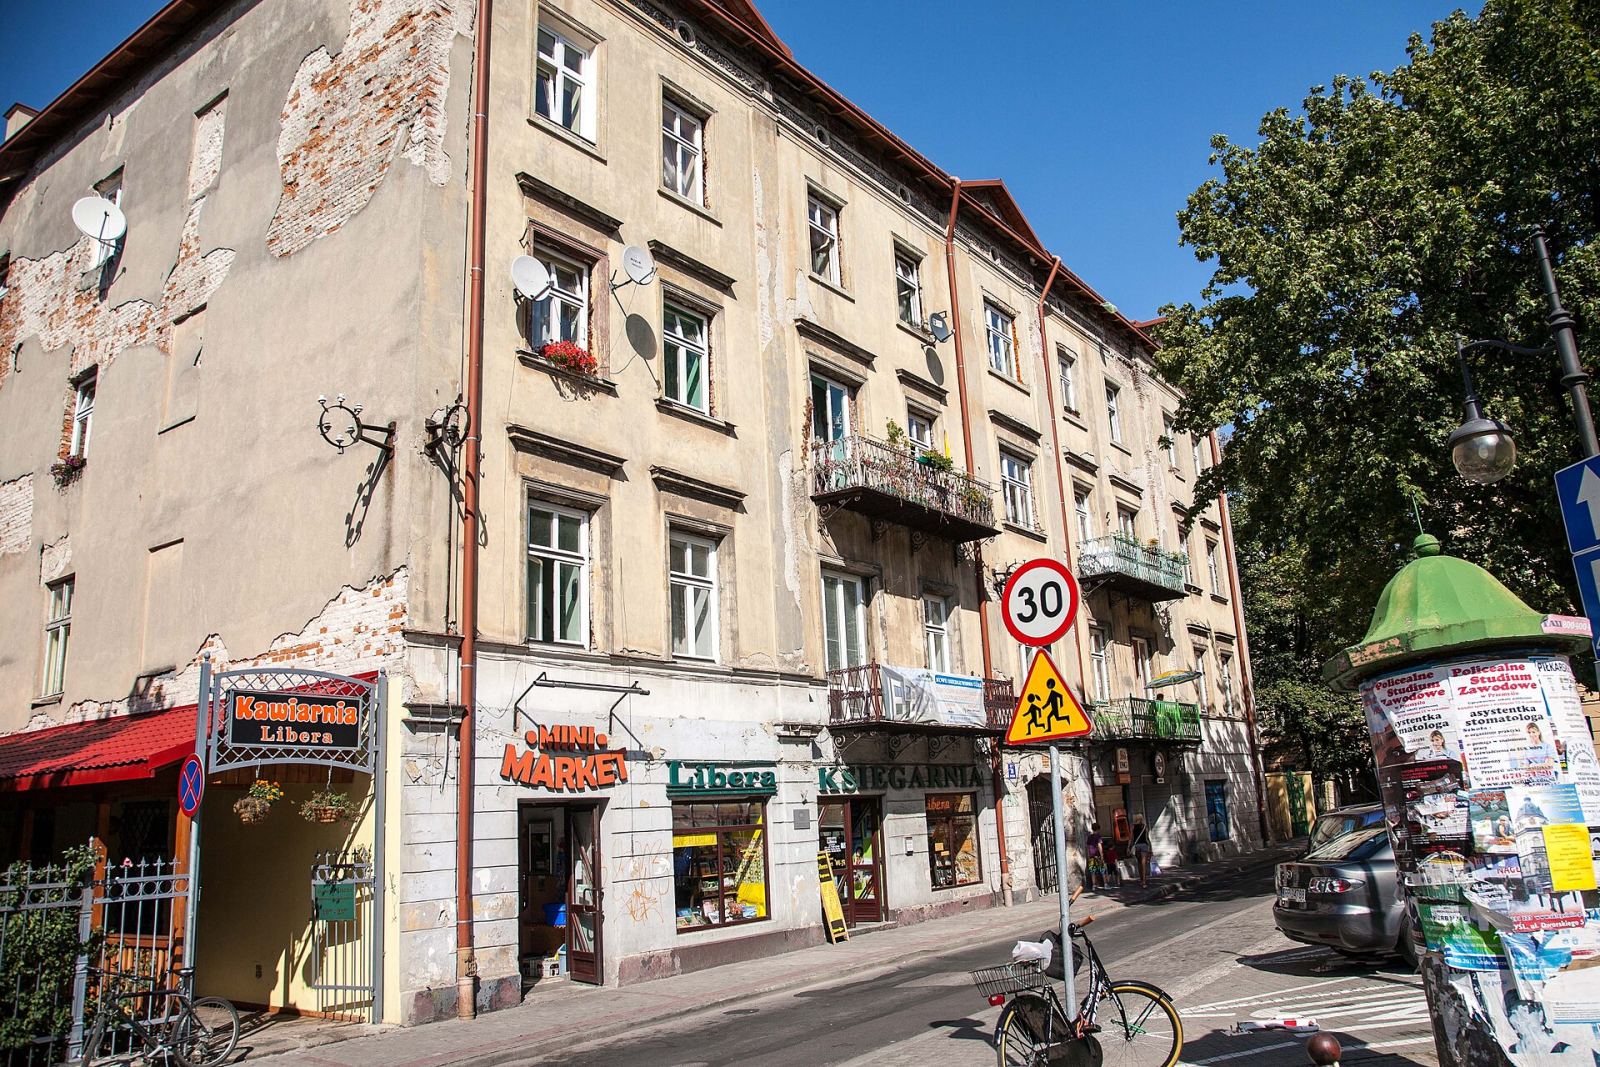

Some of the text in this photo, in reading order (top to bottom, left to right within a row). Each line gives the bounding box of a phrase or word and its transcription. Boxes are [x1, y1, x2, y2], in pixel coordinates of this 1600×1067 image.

[1017, 581, 1063, 623] 30
[1451, 663, 1525, 677] Policealne
[1375, 671, 1434, 690] Policealne
[1470, 673, 1533, 685] Studium
[1380, 688, 1445, 707] Zawodowe
[1386, 681, 1440, 697] Studium
[1458, 682, 1537, 696] Zawodowe
[235, 695, 358, 725] Kawiarnia
[1470, 705, 1537, 718] asystentka
[1394, 713, 1442, 728] ystentka
[1465, 713, 1544, 727] stomatologa
[260, 725, 333, 744] Libera
[539, 724, 596, 751] MINI
[499, 743, 628, 793] MARKET
[666, 760, 776, 788] Libera
[927, 797, 951, 810] ibera
